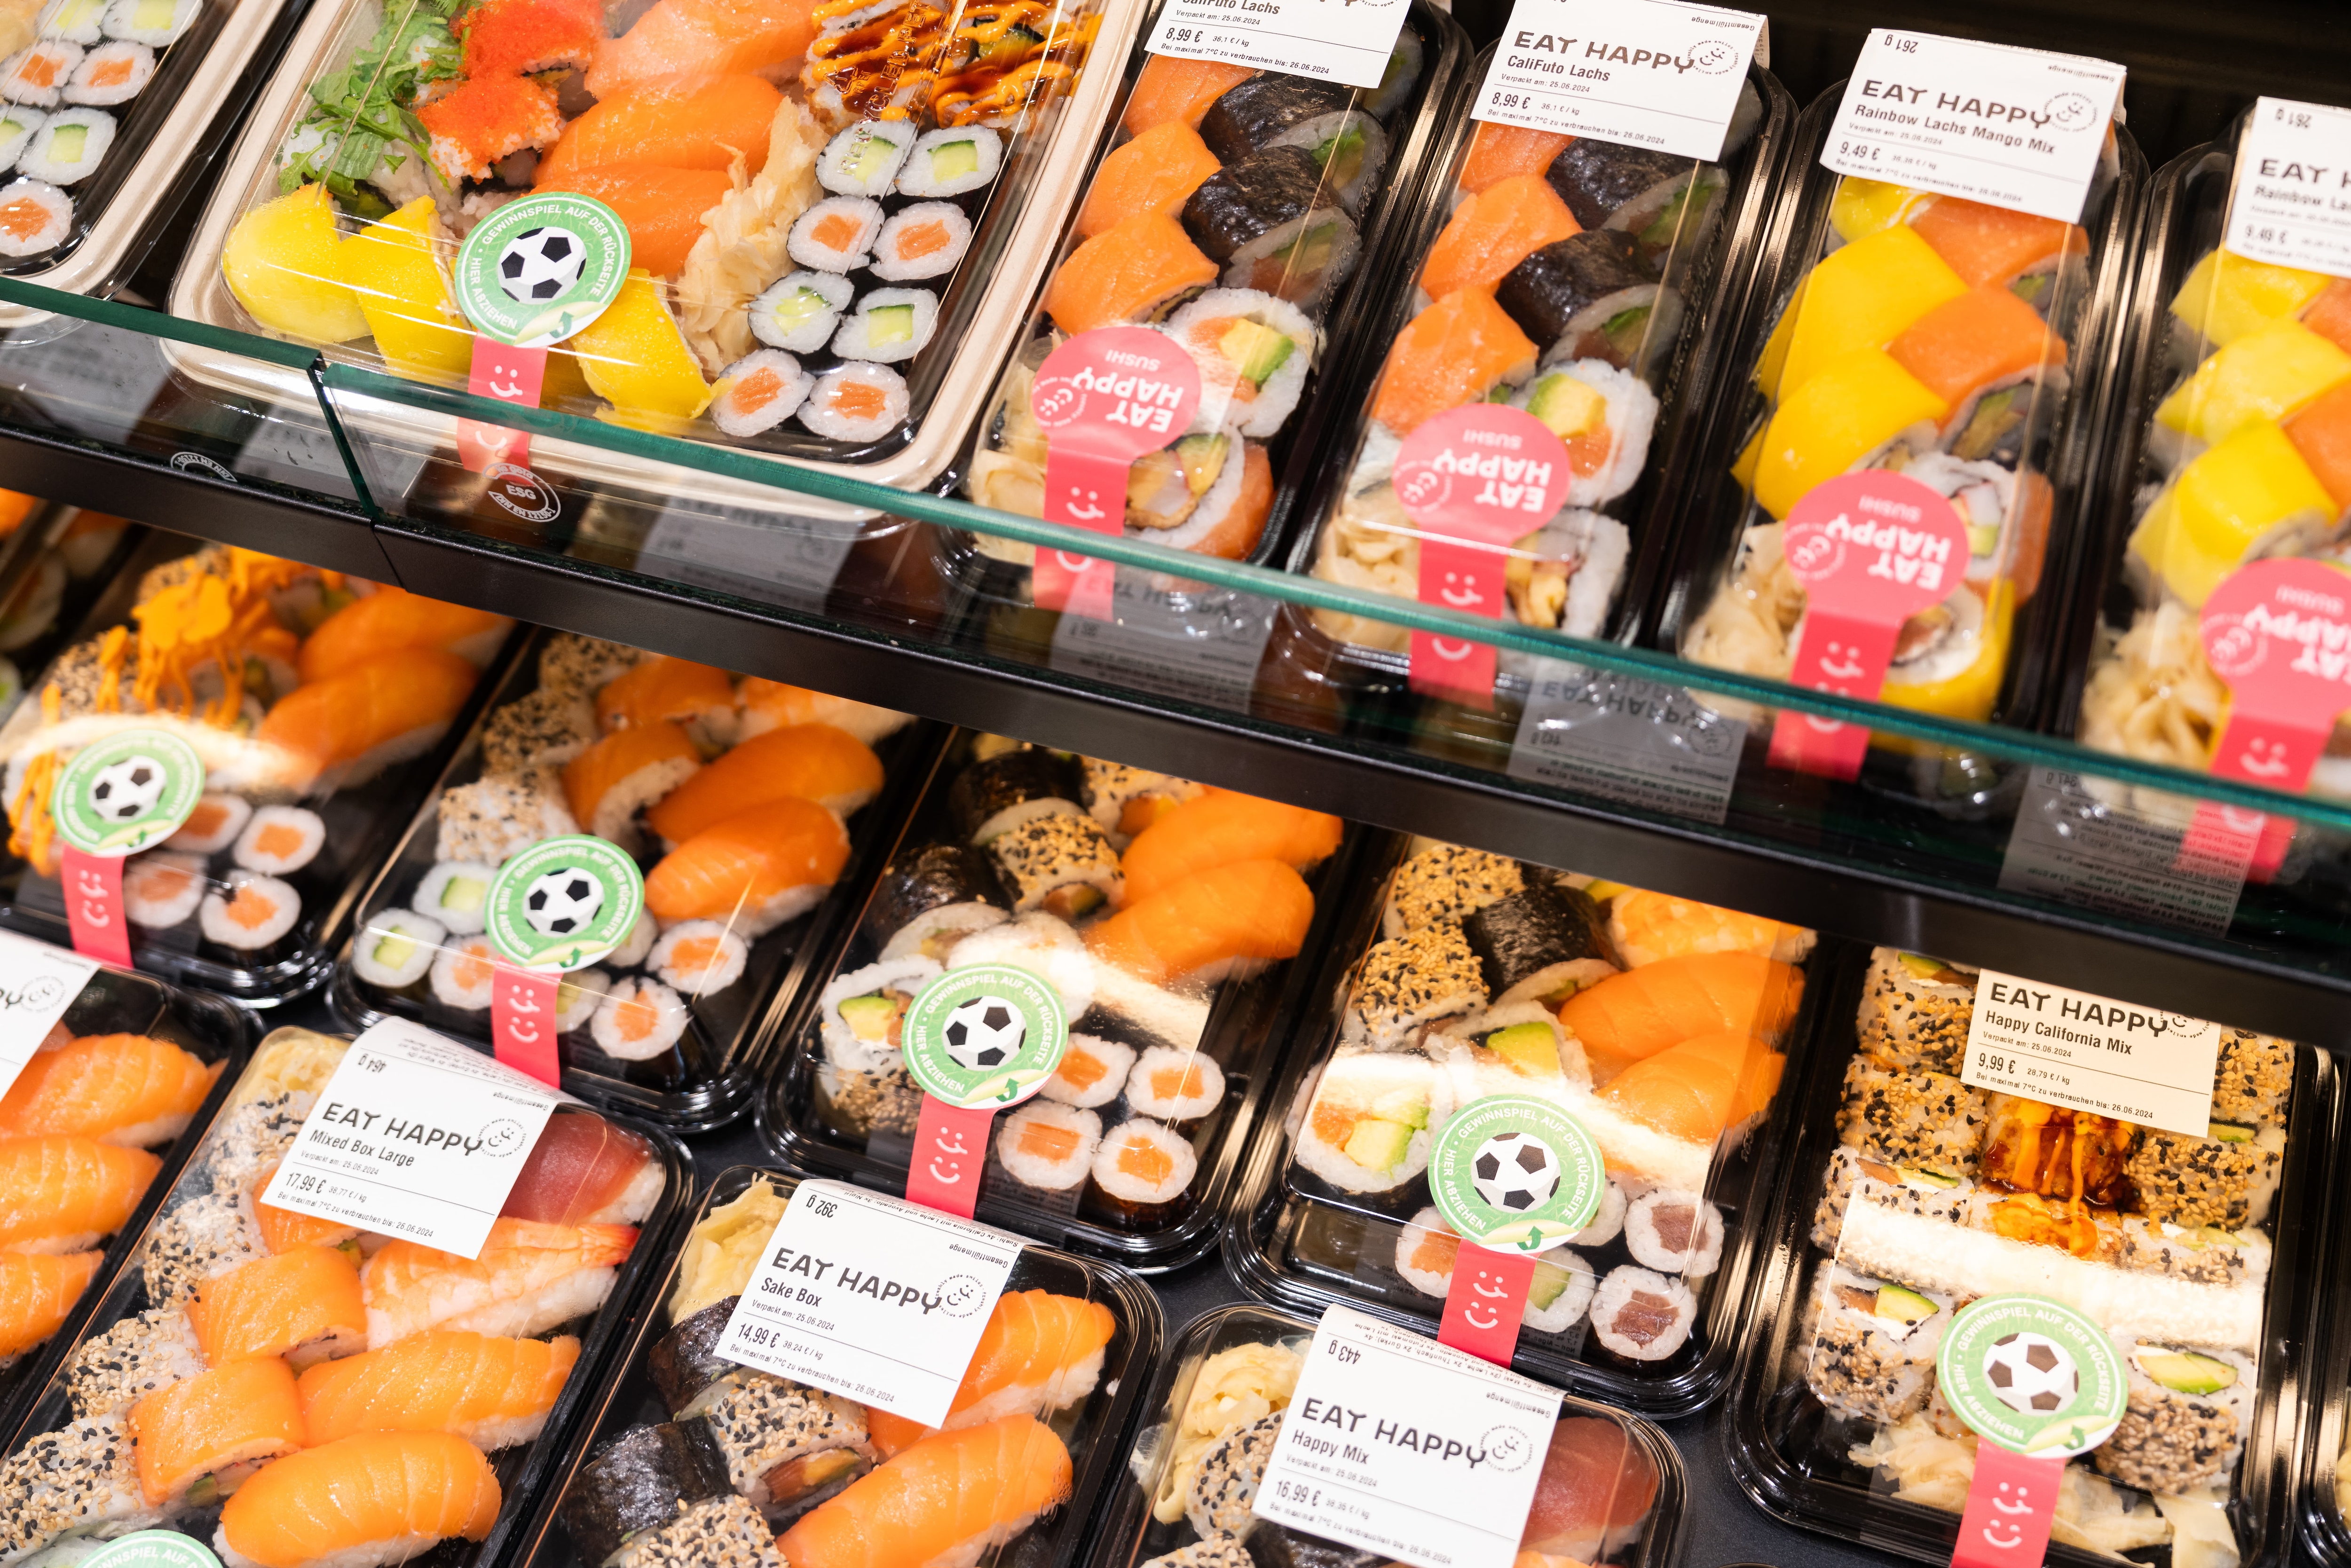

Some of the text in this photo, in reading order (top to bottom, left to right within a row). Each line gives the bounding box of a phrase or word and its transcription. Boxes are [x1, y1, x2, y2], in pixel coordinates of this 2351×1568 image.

[1176, 9, 1206, 18] Verpackt
[1221, 15, 1261, 25] 25.06.2024
[1241, 0, 1280, 15] Lachs
[1166, 27, 1192, 42] 8,99
[1194, 31, 1203, 43] €
[1884, 34, 1893, 46] g
[1895, 39, 1918, 54] 261
[1231, 53, 1273, 64] verbrauchen
[1289, 62, 1329, 74] 26.06.2024
[1507, 55, 1610, 81] CaliFuto Lachs
[1514, 31, 1695, 74] EAT HAPPY
[1501, 73, 1532, 84] Verpackt
[1549, 81, 1590, 93] 25.06.2024
[1492, 92, 1531, 110] 8,99 €
[1862, 79, 2050, 129] EAT HAPPY
[1854, 104, 1918, 125] Rainbow
[1924, 117, 1967, 135] Lachs
[1972, 126, 2022, 147] Mango
[2028, 138, 2055, 154] Mix
[1840, 141, 1868, 158] 9,49
[2259, 158, 2328, 184] EAT
[482, 205, 617, 297] GEWINNSPIEL AUF DER RÜCKSEITE
[470, 257, 518, 329] HIER ABZIEHEN
[1105, 349, 1161, 371] SUSHI
[1071, 367, 1184, 409] HAPPY
[1106, 400, 1175, 433] EAT
[1463, 429, 1523, 450] SUSHI
[1432, 449, 1553, 486] HAPPY
[495, 494, 511, 509] DIN
[513, 508, 526, 517] EN
[506, 484, 536, 500] ESG
[1474, 481, 1547, 512] EAT
[1825, 513, 1952, 563] HAPPY
[1867, 552, 1944, 591] EAT
[925, 974, 1054, 1065] GEWINNSPIEL AUF DER RÜCKSEITE
[1990, 982, 2168, 1038] EAT HAPPY
[1983, 1031, 2014, 1044] Verpackt
[2031, 1042, 2071, 1057] 25.06.2024
[1985, 1010, 2132, 1055] Happy California Mix
[916, 1025, 965, 1093] HIER ABZIEHEN
[1978, 1053, 2004, 1072] 9,99
[2008, 1060, 2016, 1074] €
[2027, 1068, 2048, 1079] 28,79
[2062, 1076, 2070, 1086] kg
[1976, 1072, 1987, 1080] Bei
[1990, 1077, 2020, 1088] maximal
[2023, 1083, 2036, 1092] 7°C
[2050, 1091, 2094, 1105] verbrauchen
[2096, 1100, 2109, 1109] bis:
[2112, 1103, 2153, 1119] 26.06.2024
[322, 1102, 484, 1156] EAT HAPPY
[309, 1129, 415, 1166] Mixed Box Large
[1458, 1108, 1591, 1220] GEWINNSPIEL AUF DER RÜCKSEITE
[286, 1173, 327, 1194] 17,99 €
[1444, 1148, 1487, 1230] HIER ABZIEHEN
[805, 1194, 838, 1218] 392 g
[949, 1244, 1008, 1269] Gesamtfüllmenge
[761, 1277, 822, 1307] Sake Box
[772, 1247, 943, 1315] EAT HAPPY
[752, 1299, 835, 1331] Verpackt am: 25.06.2024
[738, 1323, 769, 1345] 14,99
[770, 1332, 781, 1348] €
[783, 1340, 803, 1352] 38,24
[814, 1350, 823, 1361] kg
[1957, 1307, 2111, 1410] GEWINNSPIEL AUF DER RÜCKSEITE
[730, 1343, 742, 1353] Bei
[742, 1349, 772, 1363] maximal
[773, 1356, 787, 1367] 7°C
[797, 1366, 839, 1384] verbrauchen
[840, 1379, 855, 1389] bis:
[855, 1383, 895, 1403] 26.06.2024
[1954, 1363, 2025, 1440] HIER ABZIEHEN
[1292, 1429, 1369, 1465] Happy Mix
[1302, 1397, 1487, 1469] EAT HAPPY
[1276, 1481, 1309, 1503] 16,99
[162, 1548, 189, 1567] AUF
